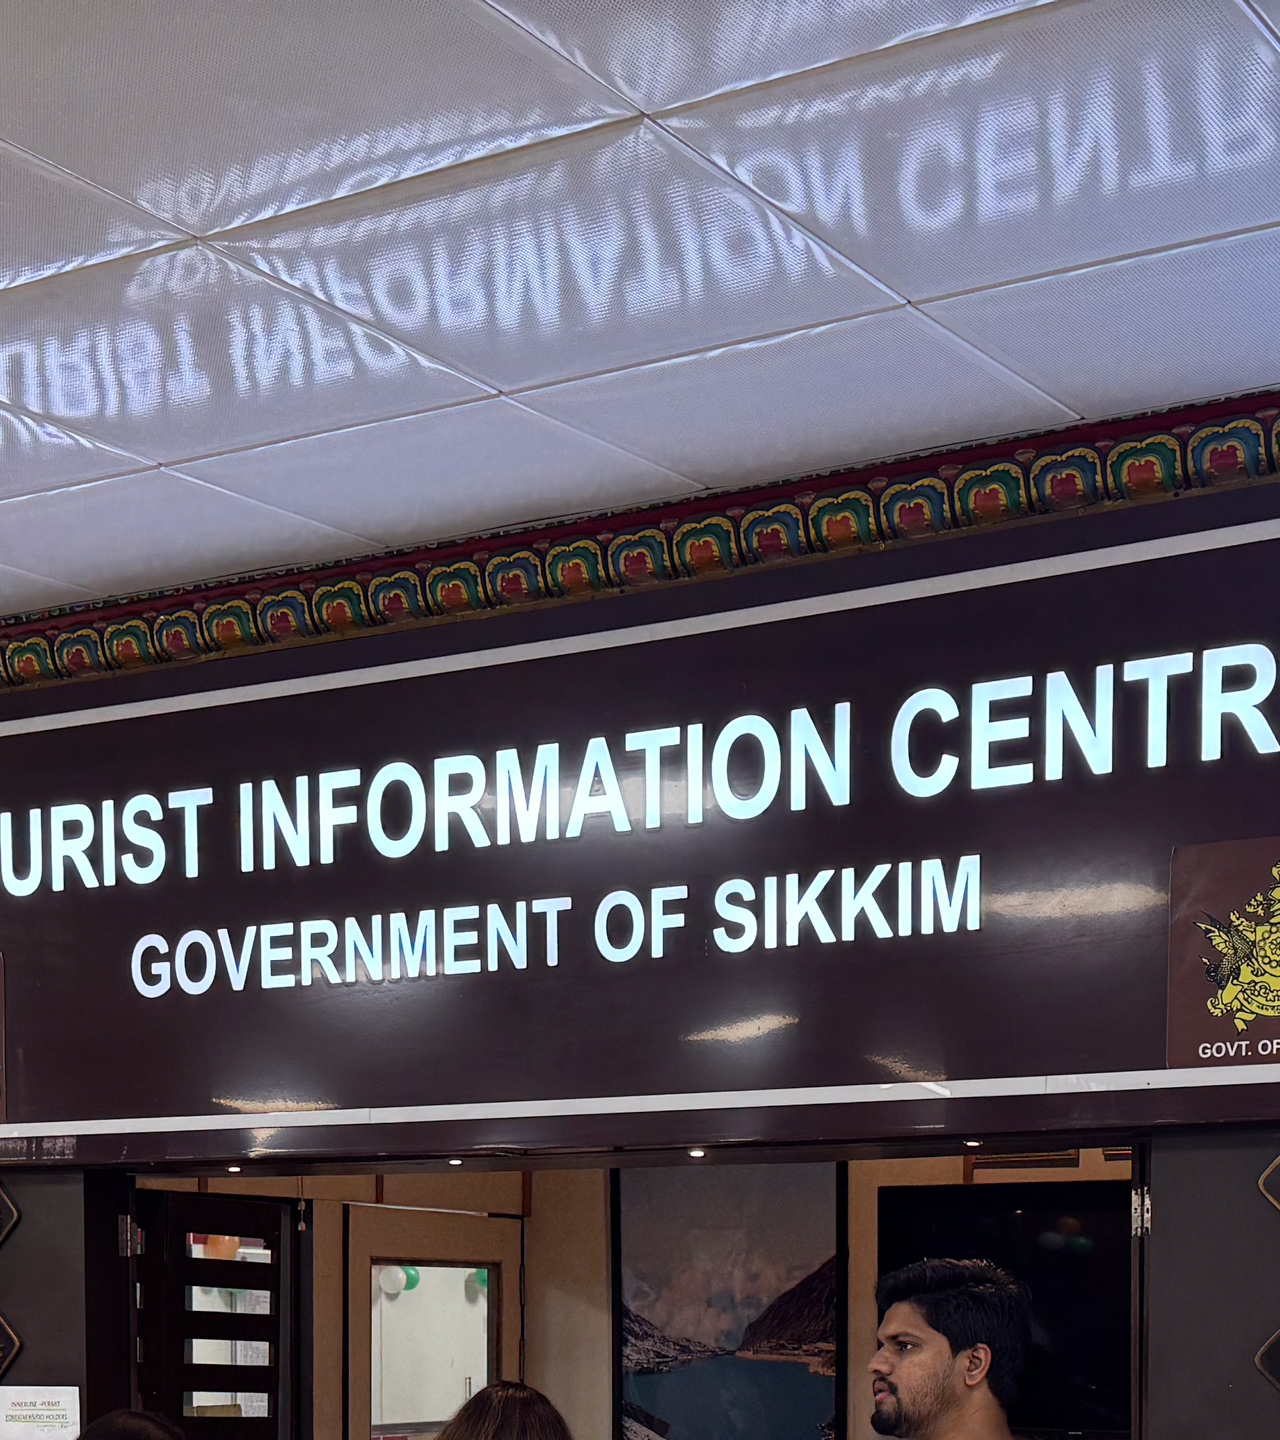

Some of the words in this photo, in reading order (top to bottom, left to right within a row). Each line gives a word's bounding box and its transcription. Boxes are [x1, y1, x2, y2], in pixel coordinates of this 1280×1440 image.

[240, 701, 851, 874] INFORMATION
[131, 896, 572, 999] GOVERNMENT
[594, 885, 688, 963] OF
[713, 854, 980, 954] SIKKIM
[1198, 1041, 1252, 1059] GOVT.
